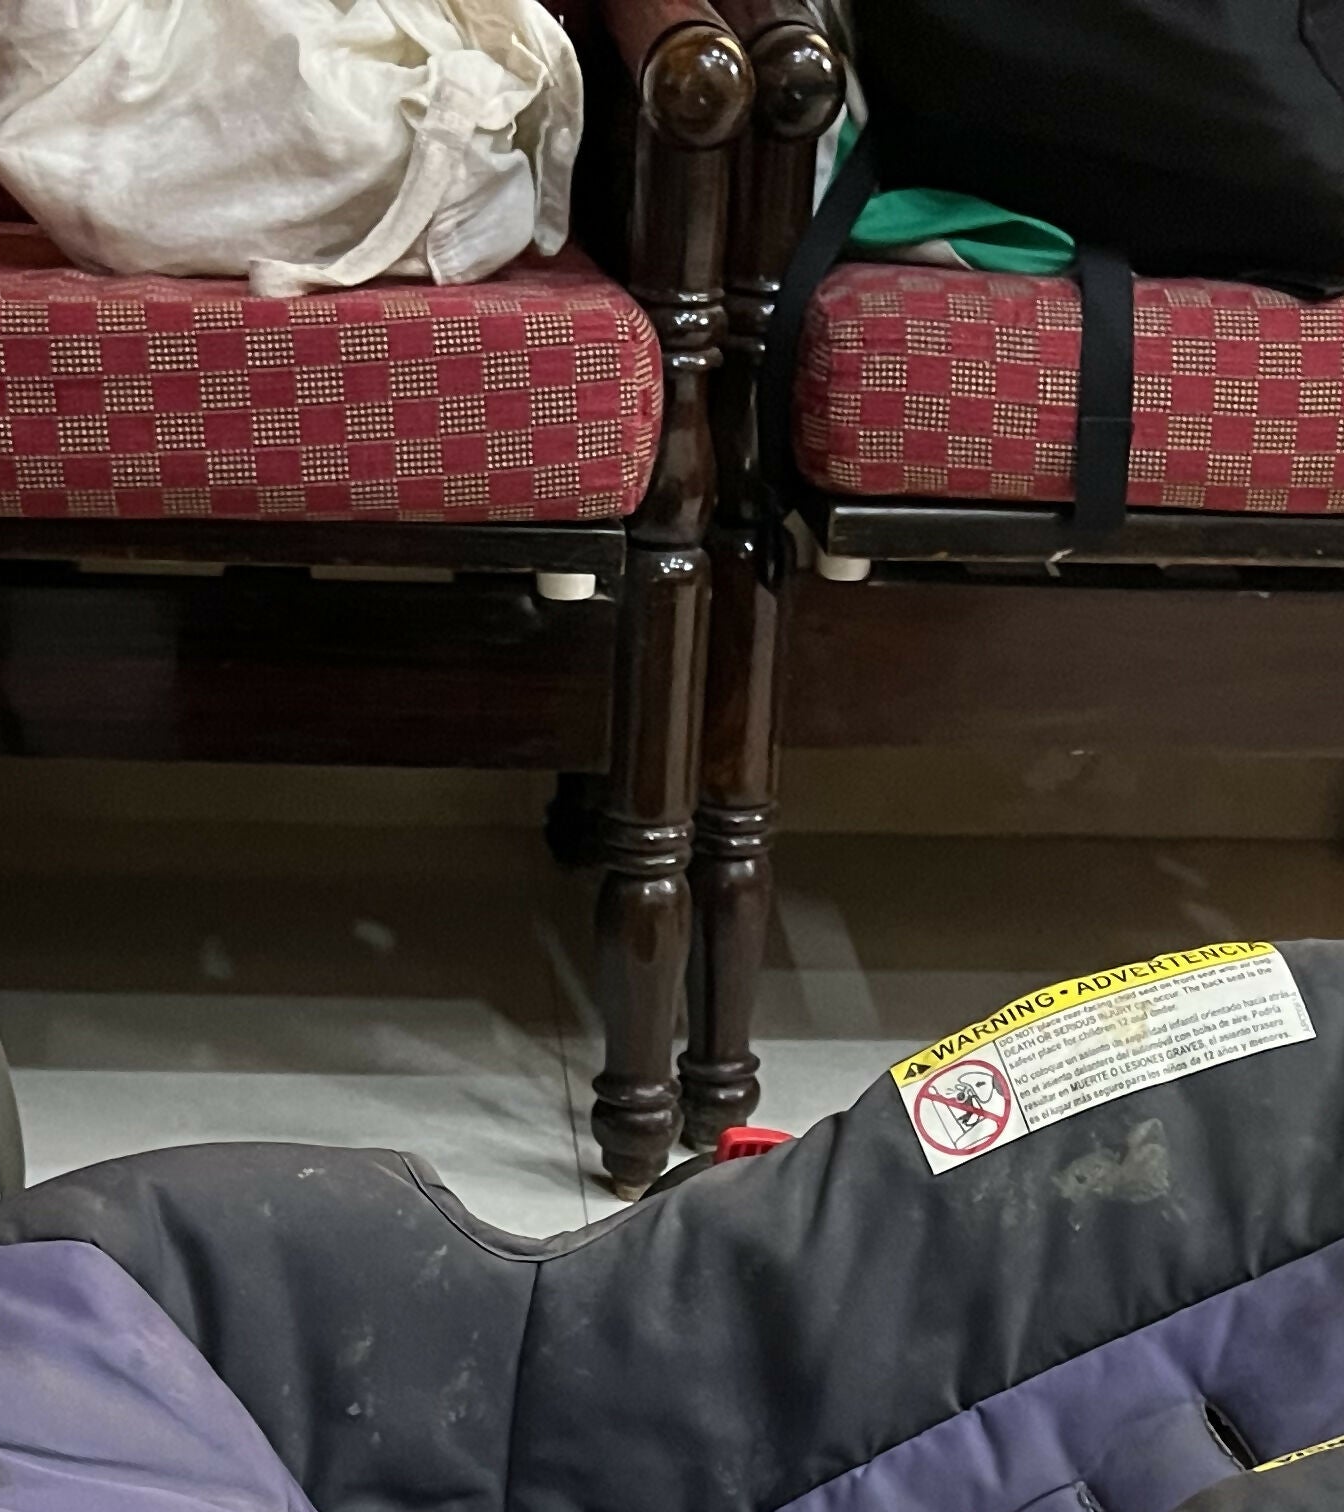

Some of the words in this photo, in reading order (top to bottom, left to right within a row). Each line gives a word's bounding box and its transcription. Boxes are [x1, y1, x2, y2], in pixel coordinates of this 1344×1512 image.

[930, 992, 1055, 1061] WARNING
[1076, 941, 1268, 996] ADVERTENCIA
[1004, 1040, 1036, 1058] DEATH
[1037, 1031, 1052, 1044] OR
[1054, 1015, 1097, 1037] SERIOUS
[1182, 983, 1201, 995] The
[1201, 978, 1225, 990] back
[1015, 1025, 1037, 1041] NOT
[1174, 1032, 1192, 1043] con
[1192, 1022, 1218, 1037] bolsa
[1218, 1019, 1230, 1029] de
[1063, 1036, 1077, 1047] for
[1078, 1023, 1117, 1042] children
[1014, 1073, 1029, 1086] NO
[1069, 1070, 1109, 1092] MUERTE
[1119, 1052, 1166, 1074] LESIONES
[1124, 1073, 1147, 1090] para
[1147, 1069, 1161, 1080] los
[1189, 1055, 1202, 1066] de
[1204, 1050, 1215, 1061] 12
[1216, 1044, 1240, 1057] años
